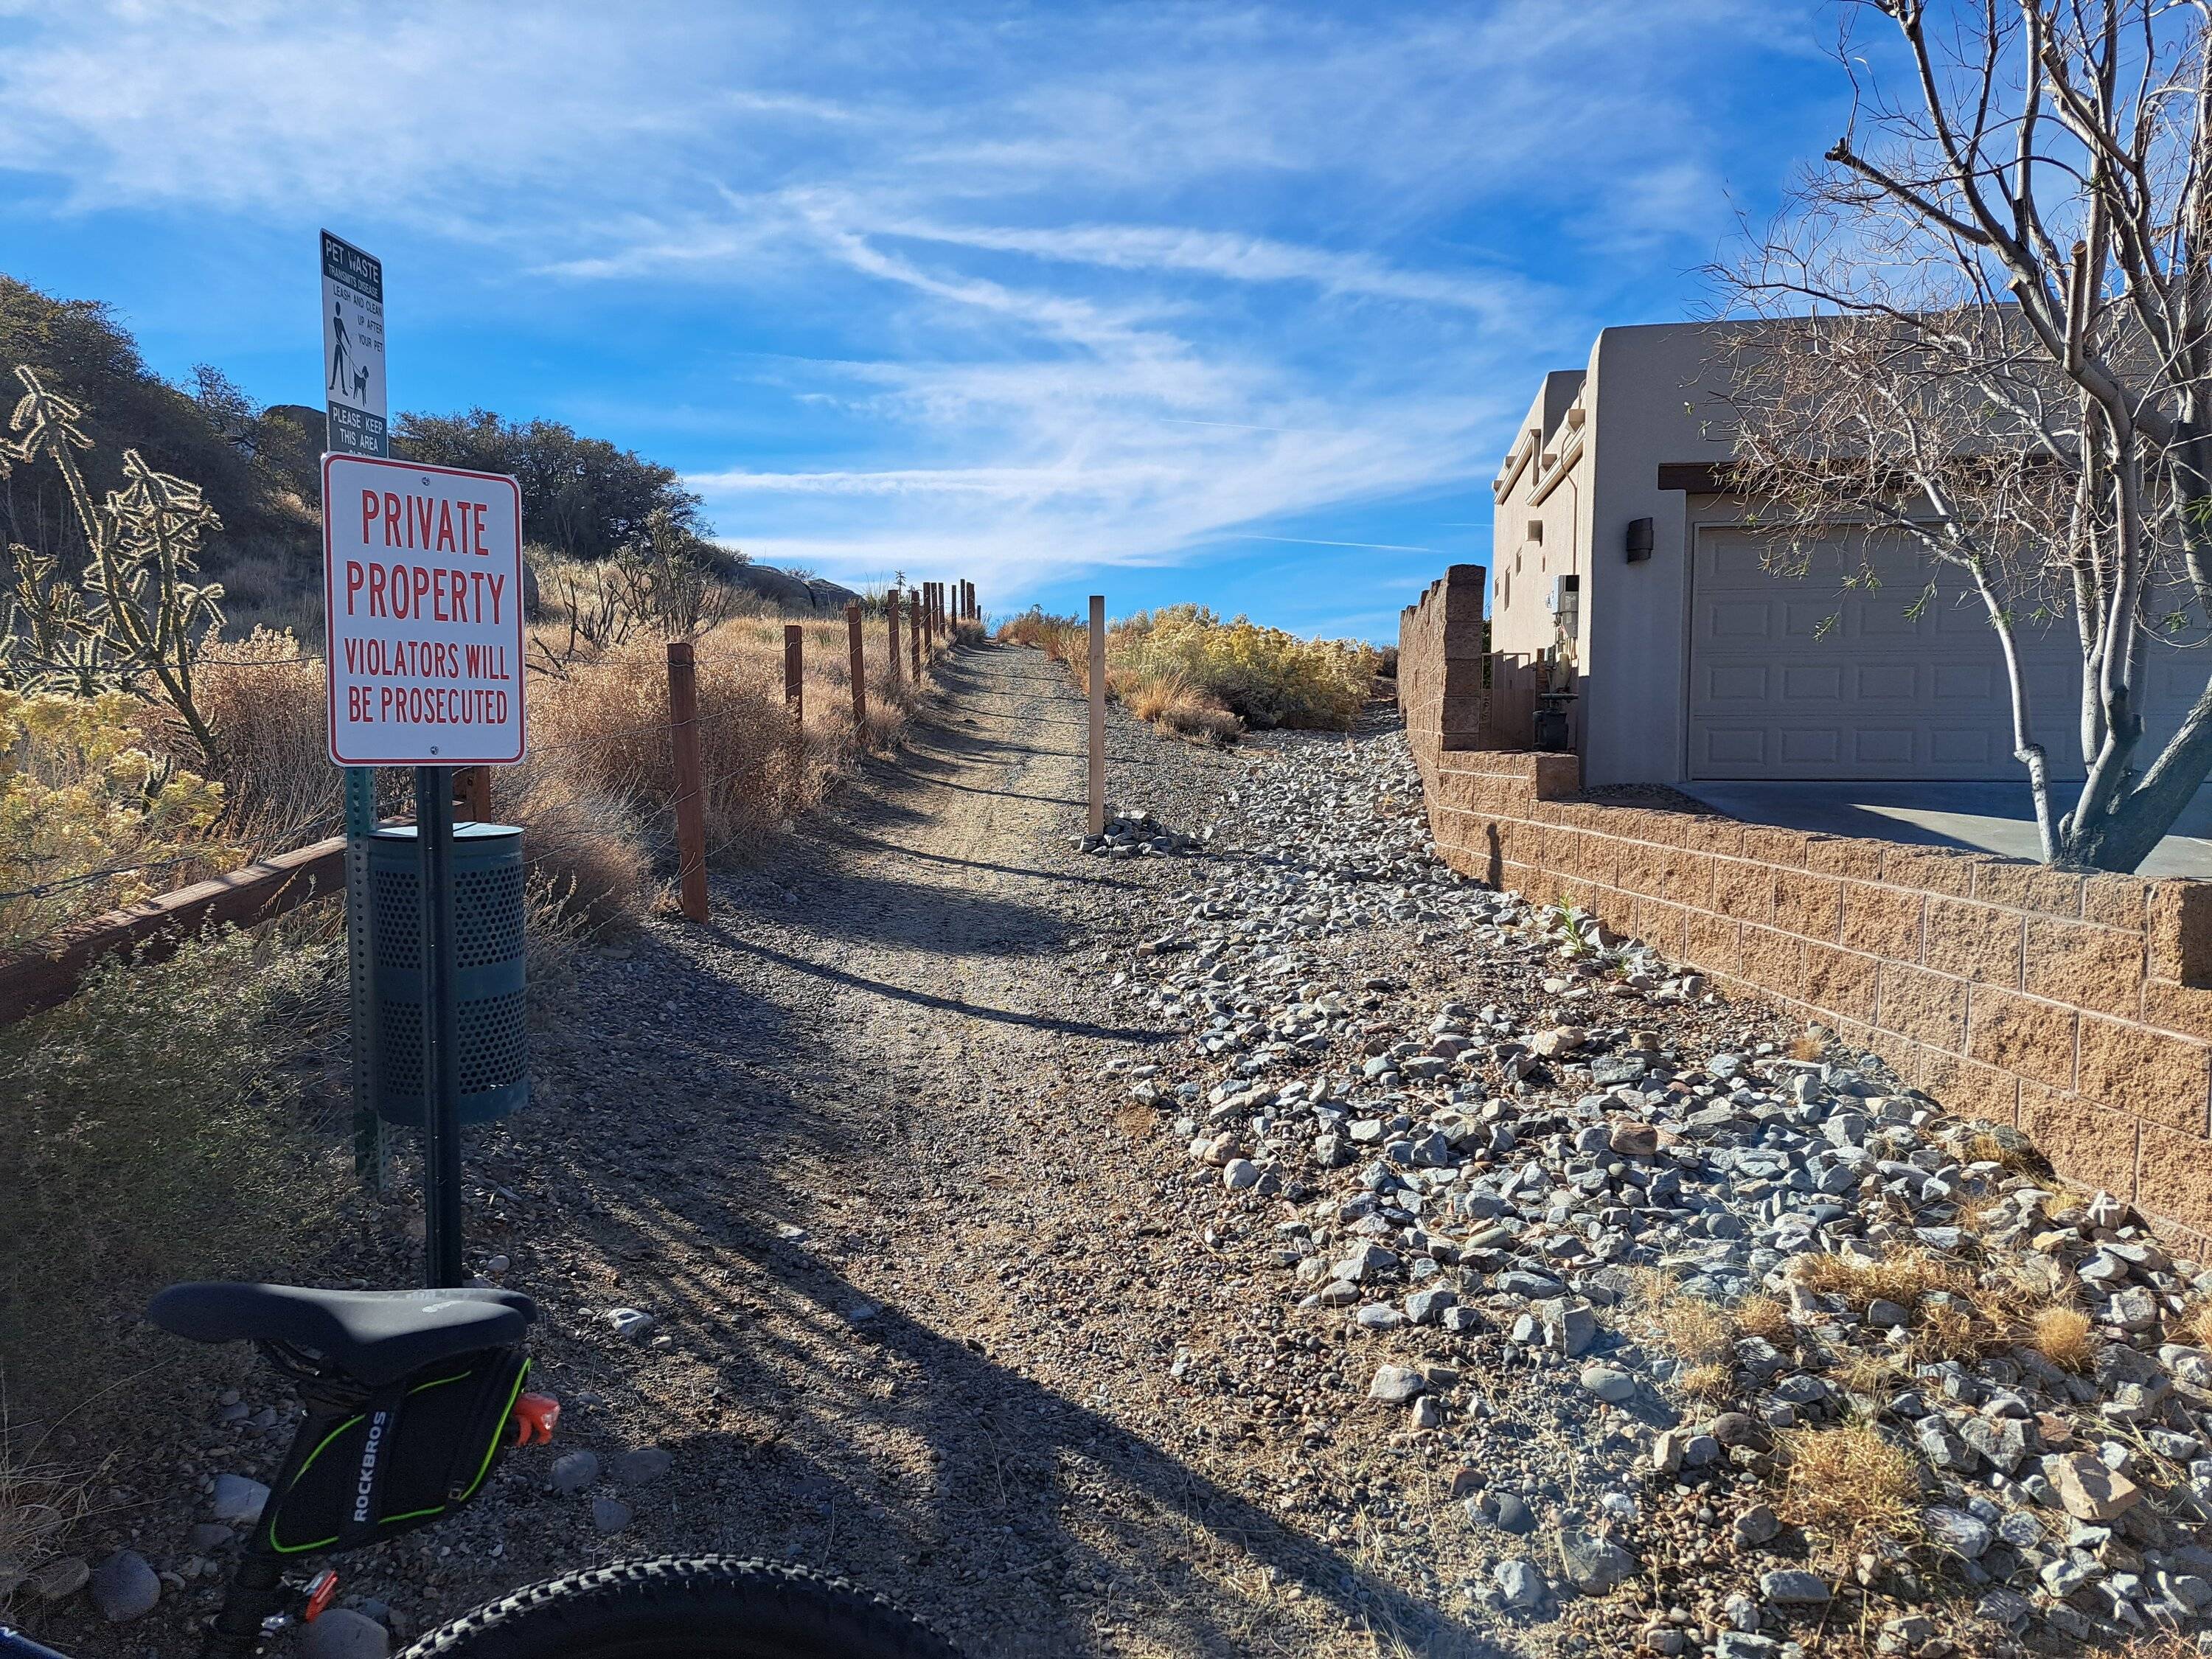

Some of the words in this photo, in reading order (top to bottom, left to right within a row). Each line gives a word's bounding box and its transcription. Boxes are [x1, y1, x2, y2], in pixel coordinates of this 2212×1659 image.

[326, 239, 344, 264] PET
[347, 251, 379, 283] WASTE
[328, 263, 357, 288] TRANSMITS
[358, 279, 378, 299] DISEASE
[333, 283, 351, 302] LEASH
[353, 294, 364, 308] AND
[366, 301, 383, 317] CLEAN
[358, 314, 364, 325] UP
[366, 319, 383, 334] AFTER
[358, 333, 372, 348] YOUR
[374, 339, 383, 353] PET
[333, 406, 361, 429] PLEASE
[365, 416, 383, 435] KEEP
[339, 428, 356, 446] THIS
[360, 434, 379, 453] AREA
[361, 489, 490, 557] PRIVATE
[347, 560, 506, 625] PROPERTY
[344, 637, 459, 679] VIOLATORS
[465, 643, 510, 681] WILL
[349, 685, 374, 723] BE
[380, 686, 508, 725] PROSECUTED
[353, 1411, 387, 1522] ROCKBROS
